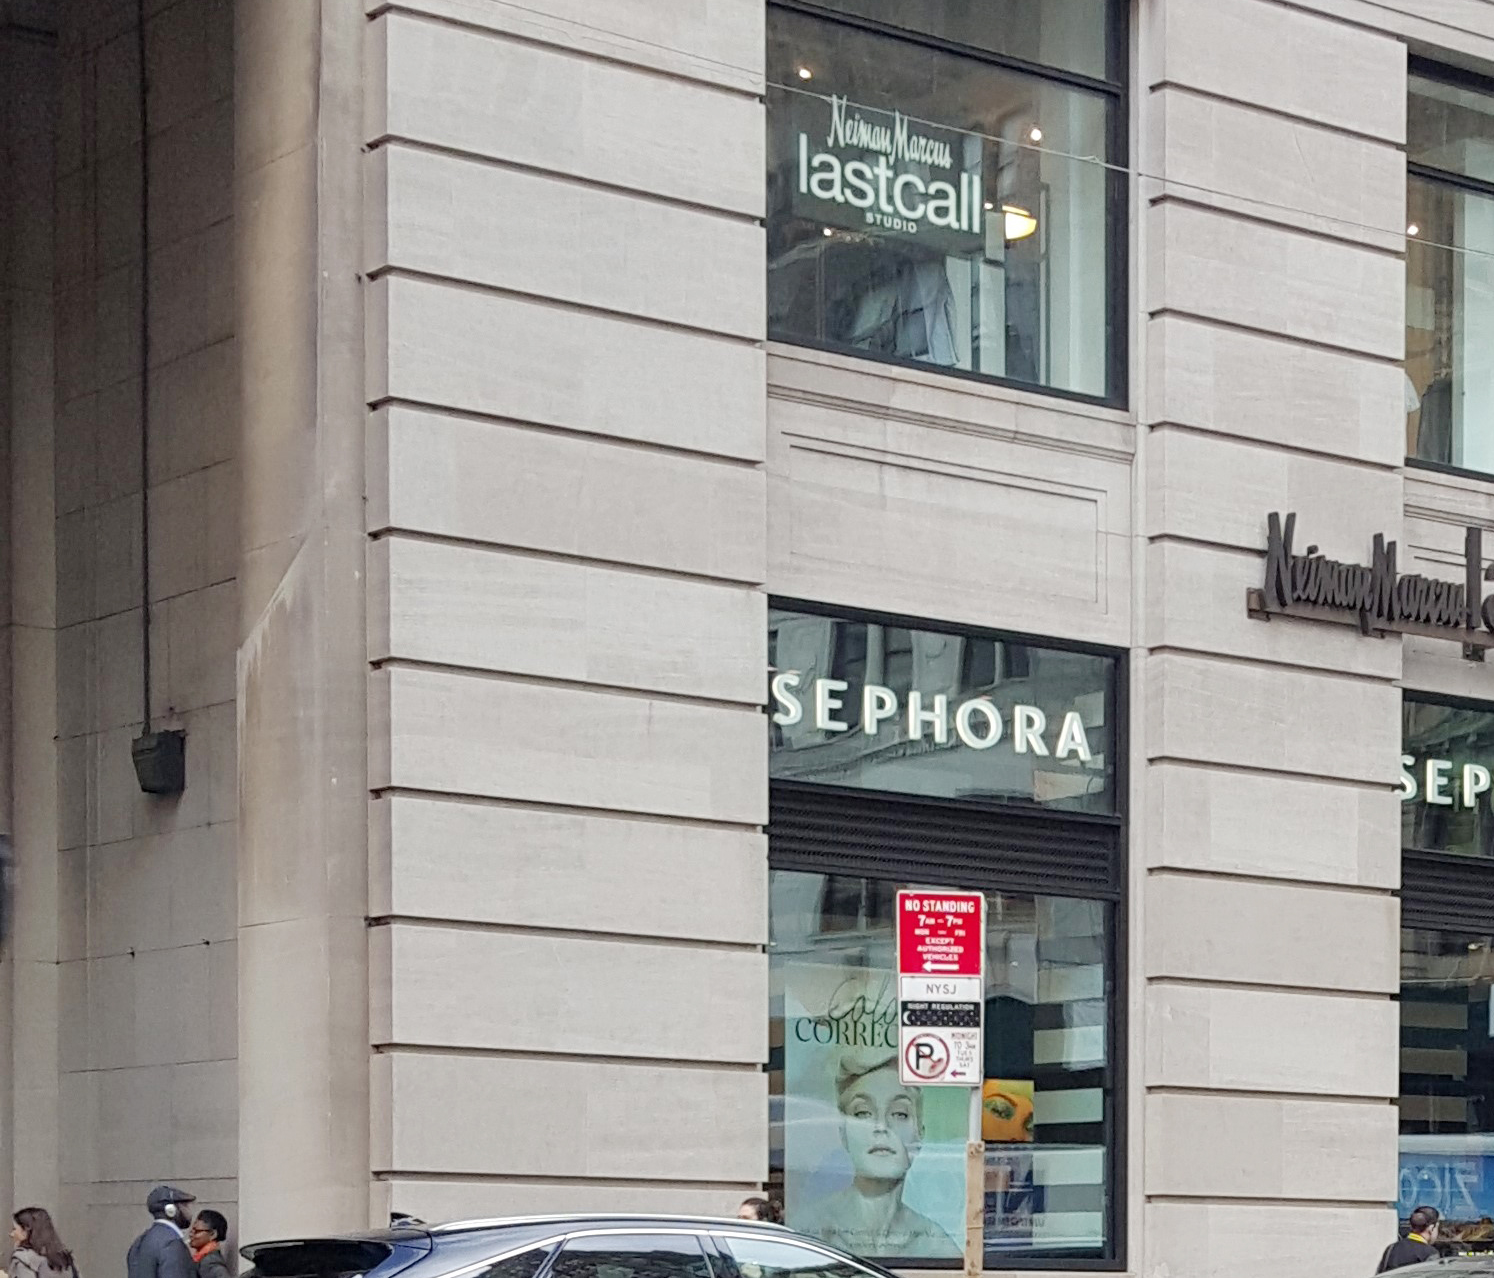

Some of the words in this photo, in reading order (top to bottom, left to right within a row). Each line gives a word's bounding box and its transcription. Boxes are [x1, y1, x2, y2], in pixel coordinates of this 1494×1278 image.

[827, 93, 892, 153] Neiman
[888, 110, 953, 169] Marcus
[799, 132, 982, 234] lastcall
[865, 211, 918, 234] STUDIO
[1264, 511, 1372, 612] Neiman
[1370, 532, 1468, 630] Marcus
[771, 672, 1092, 762] SEPHORA
[905, 899, 921, 912] NO
[922, 899, 975, 914] STANDING
[917, 914, 936, 927] 7AM
[945, 914, 963, 928] 7PM
[828, 973, 899, 1024] Colo
[926, 983, 957, 995] NYSJ
[930, 1003, 975, 1011] REGULATION
[795, 1016, 899, 1049] CORREC
